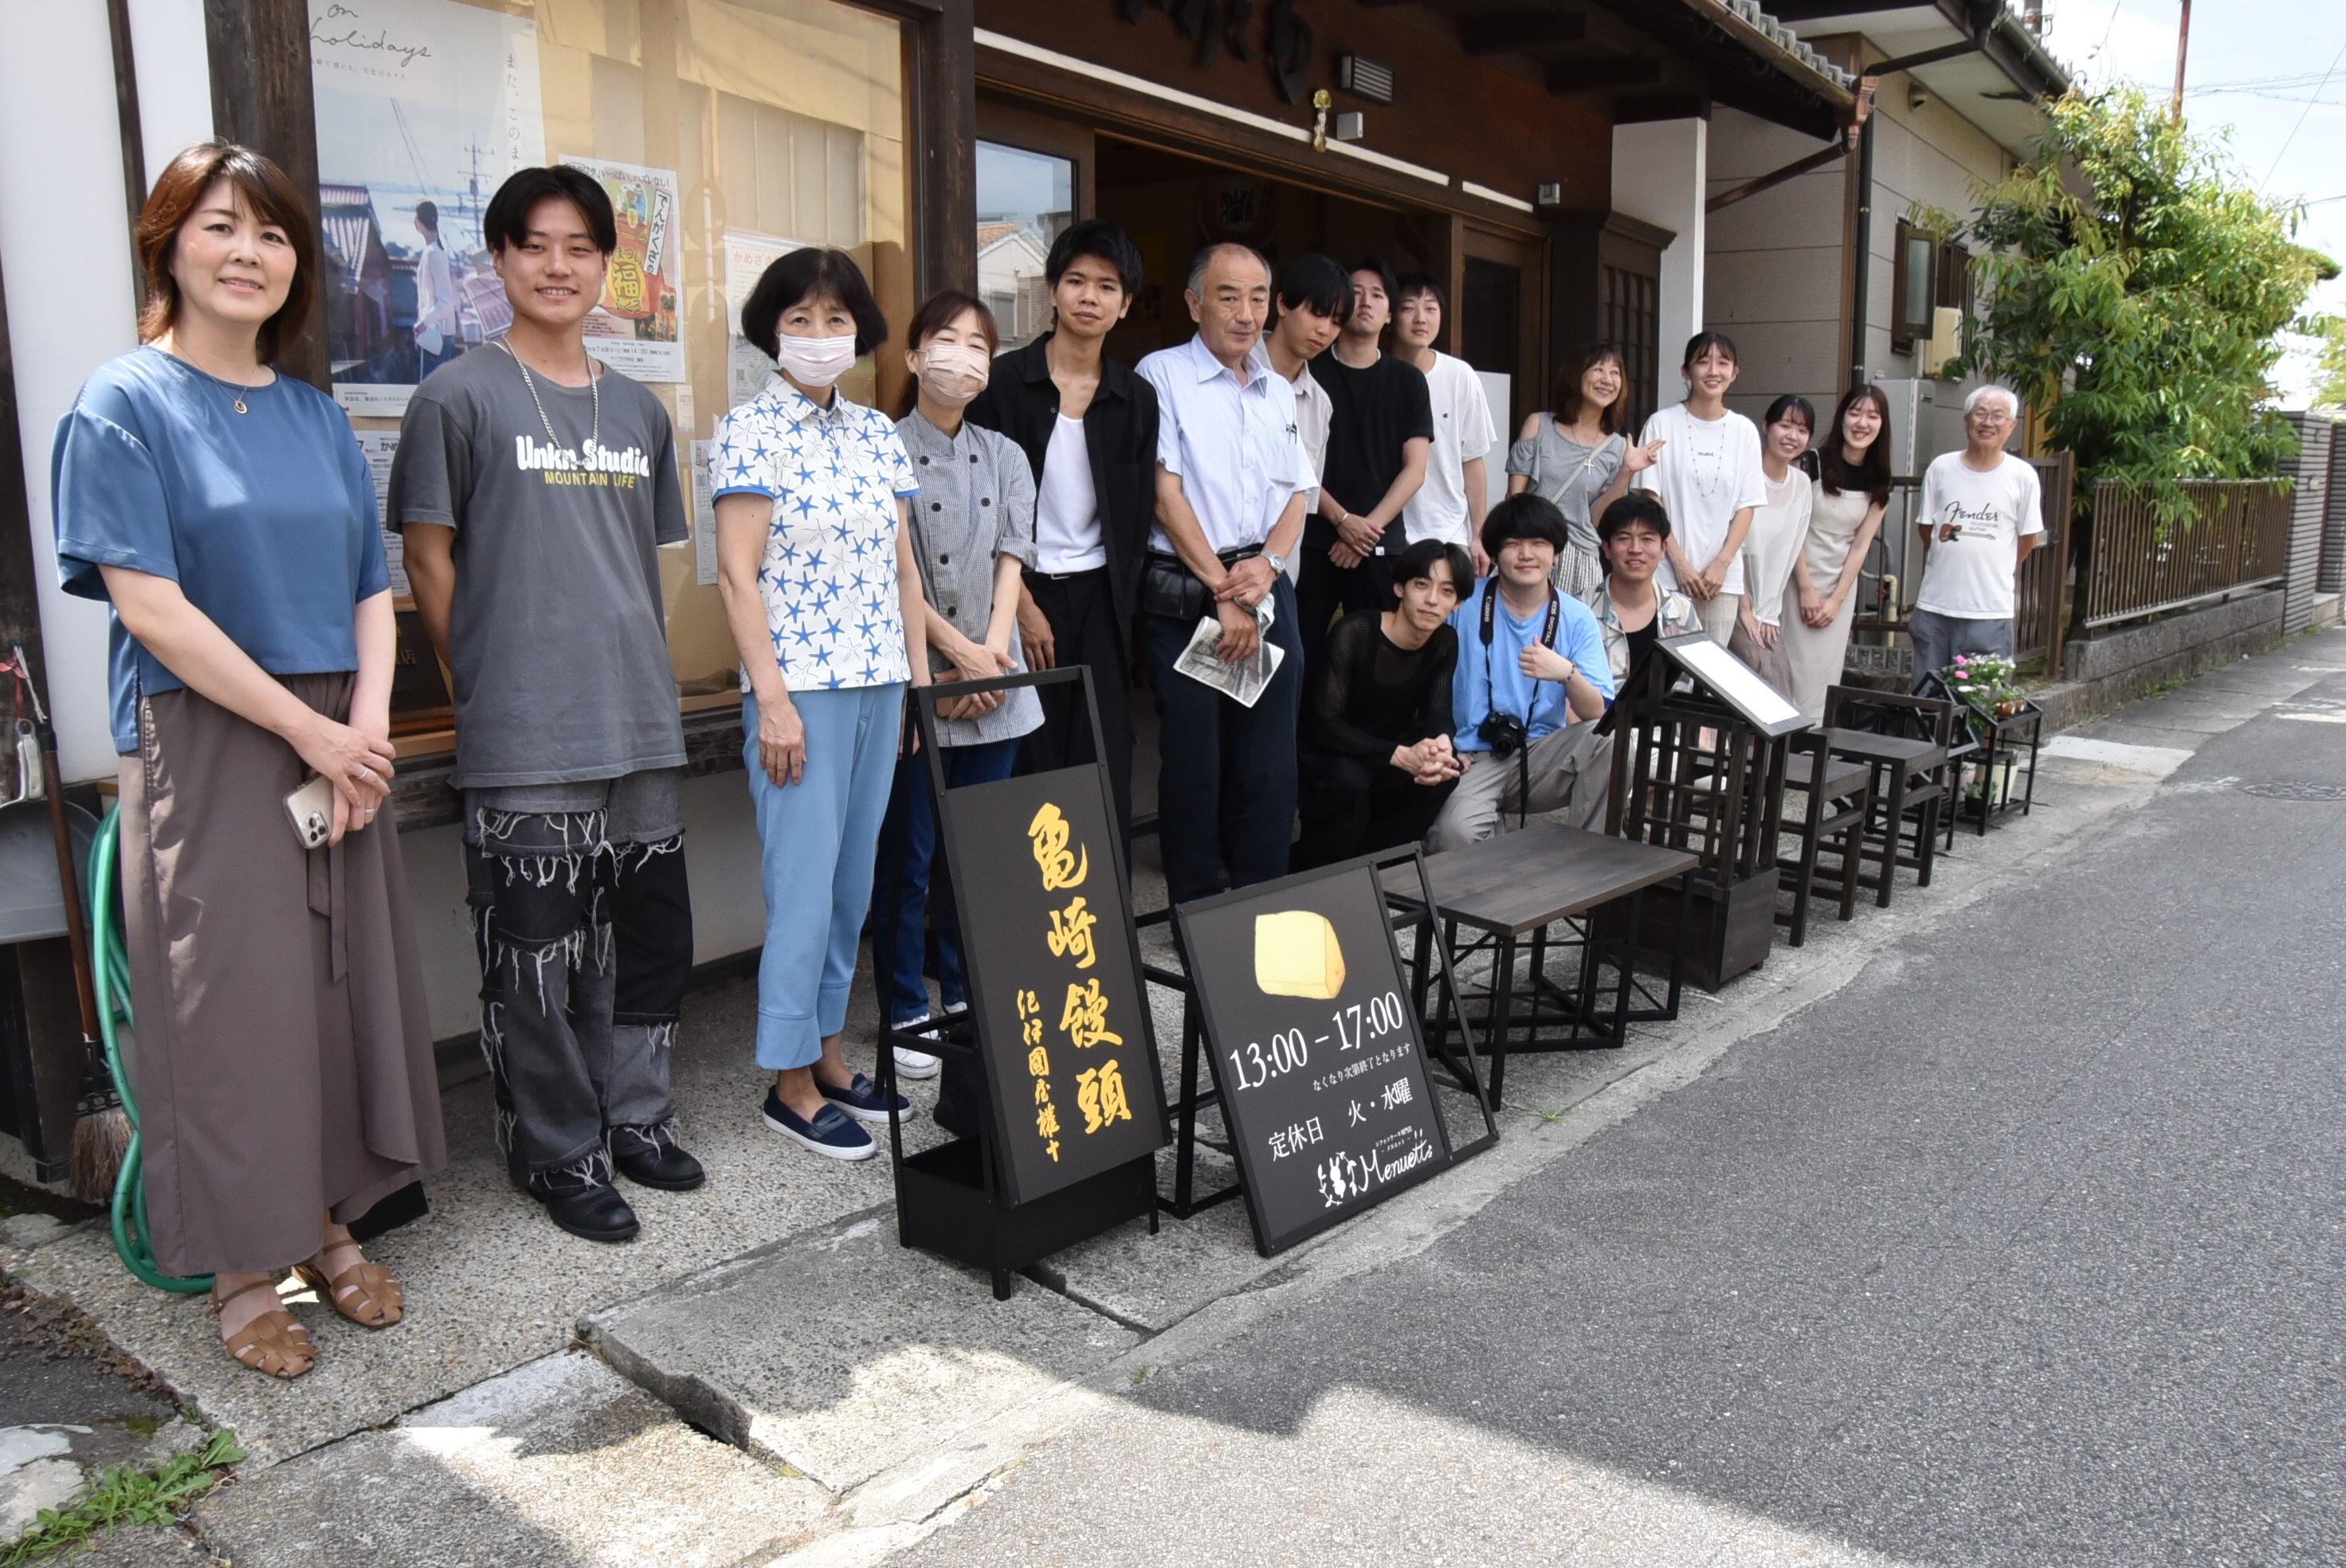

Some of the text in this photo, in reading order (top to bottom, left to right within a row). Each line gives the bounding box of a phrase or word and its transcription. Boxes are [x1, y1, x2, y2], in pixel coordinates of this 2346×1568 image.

[328, 4, 359, 18] on
[516, 435, 578, 471] Unkn
[544, 471, 636, 489] MOUNTAIN LIFE
[1944, 501, 1998, 523] Fender
[1230, 1028, 1308, 1091] 13:00
[1332, 991, 1404, 1052] 17:00
[1312, 1042, 1411, 1092] なくなり次第終了となります
[1268, 1076, 1414, 1163] 定休日 火・水曜
